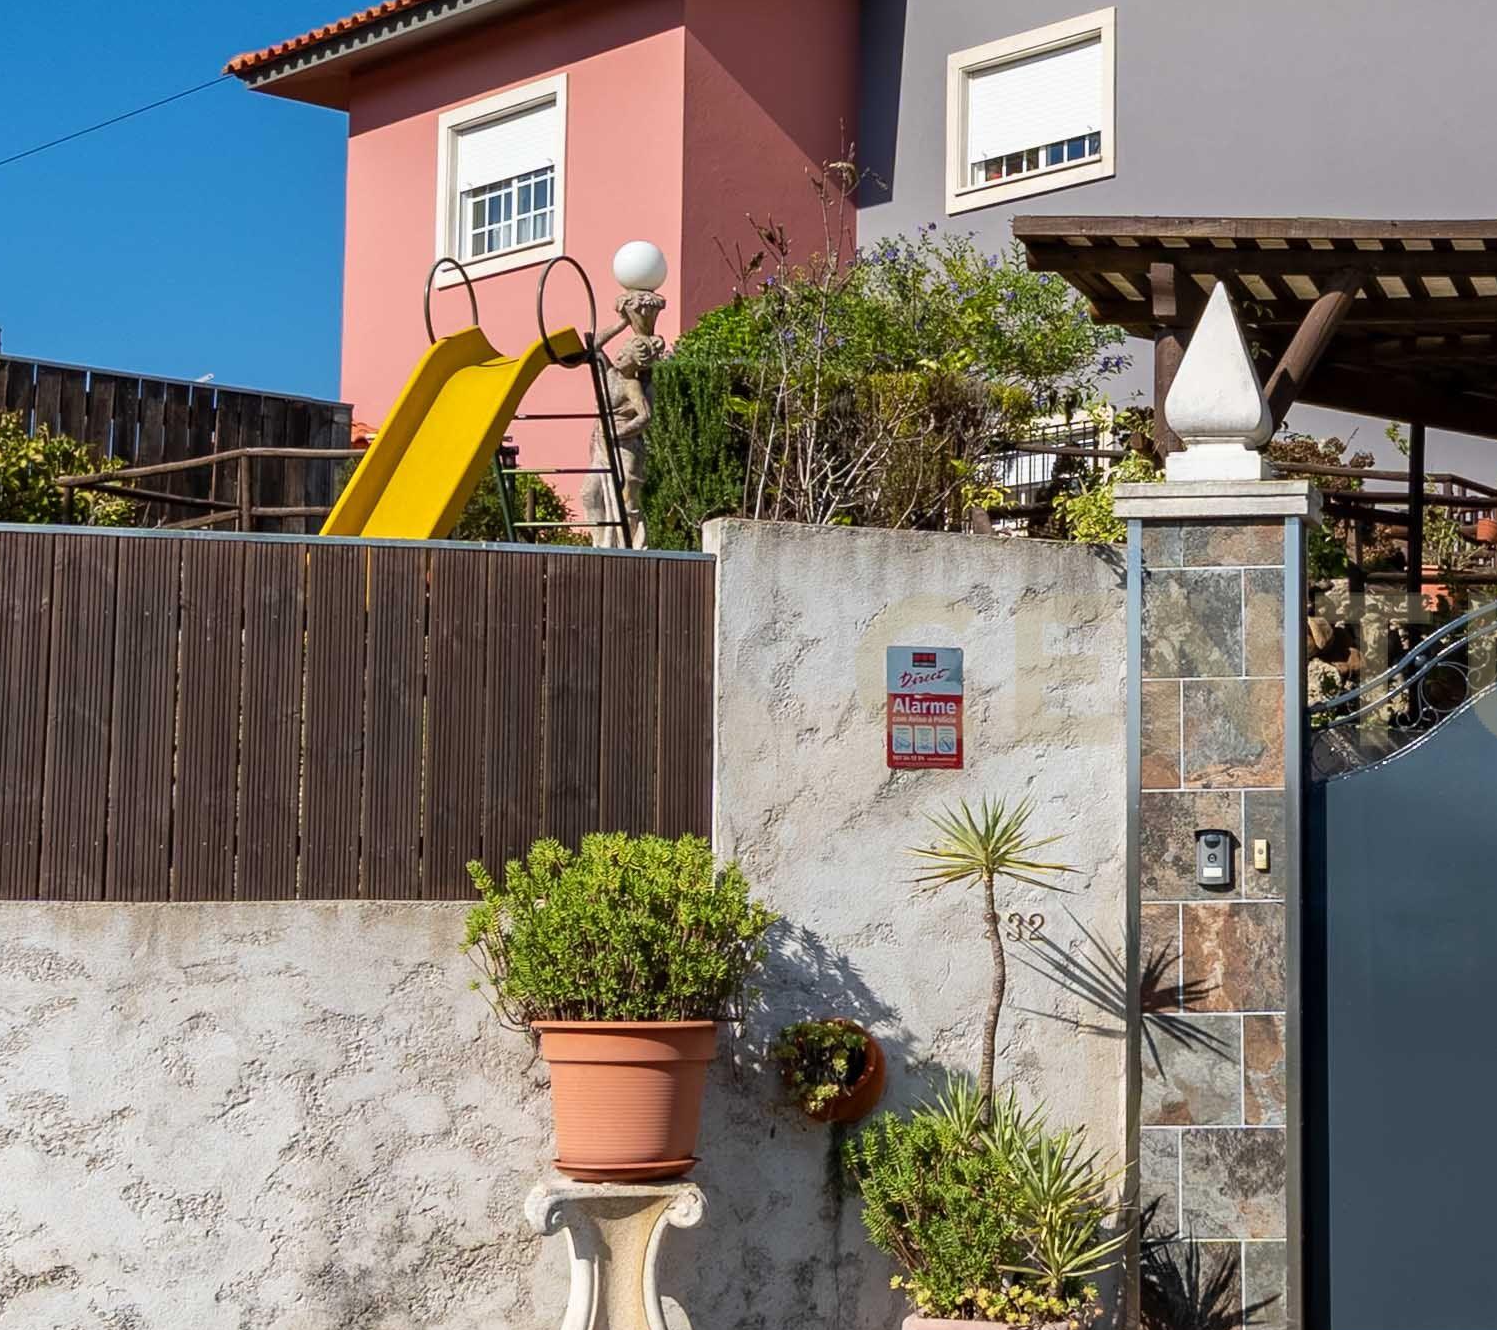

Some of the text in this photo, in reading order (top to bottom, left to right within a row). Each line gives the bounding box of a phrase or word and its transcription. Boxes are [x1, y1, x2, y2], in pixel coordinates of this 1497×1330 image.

[899, 668, 950, 688] Direct
[892, 697, 957, 715] Alarme
[983, 912, 1045, 942] 32
